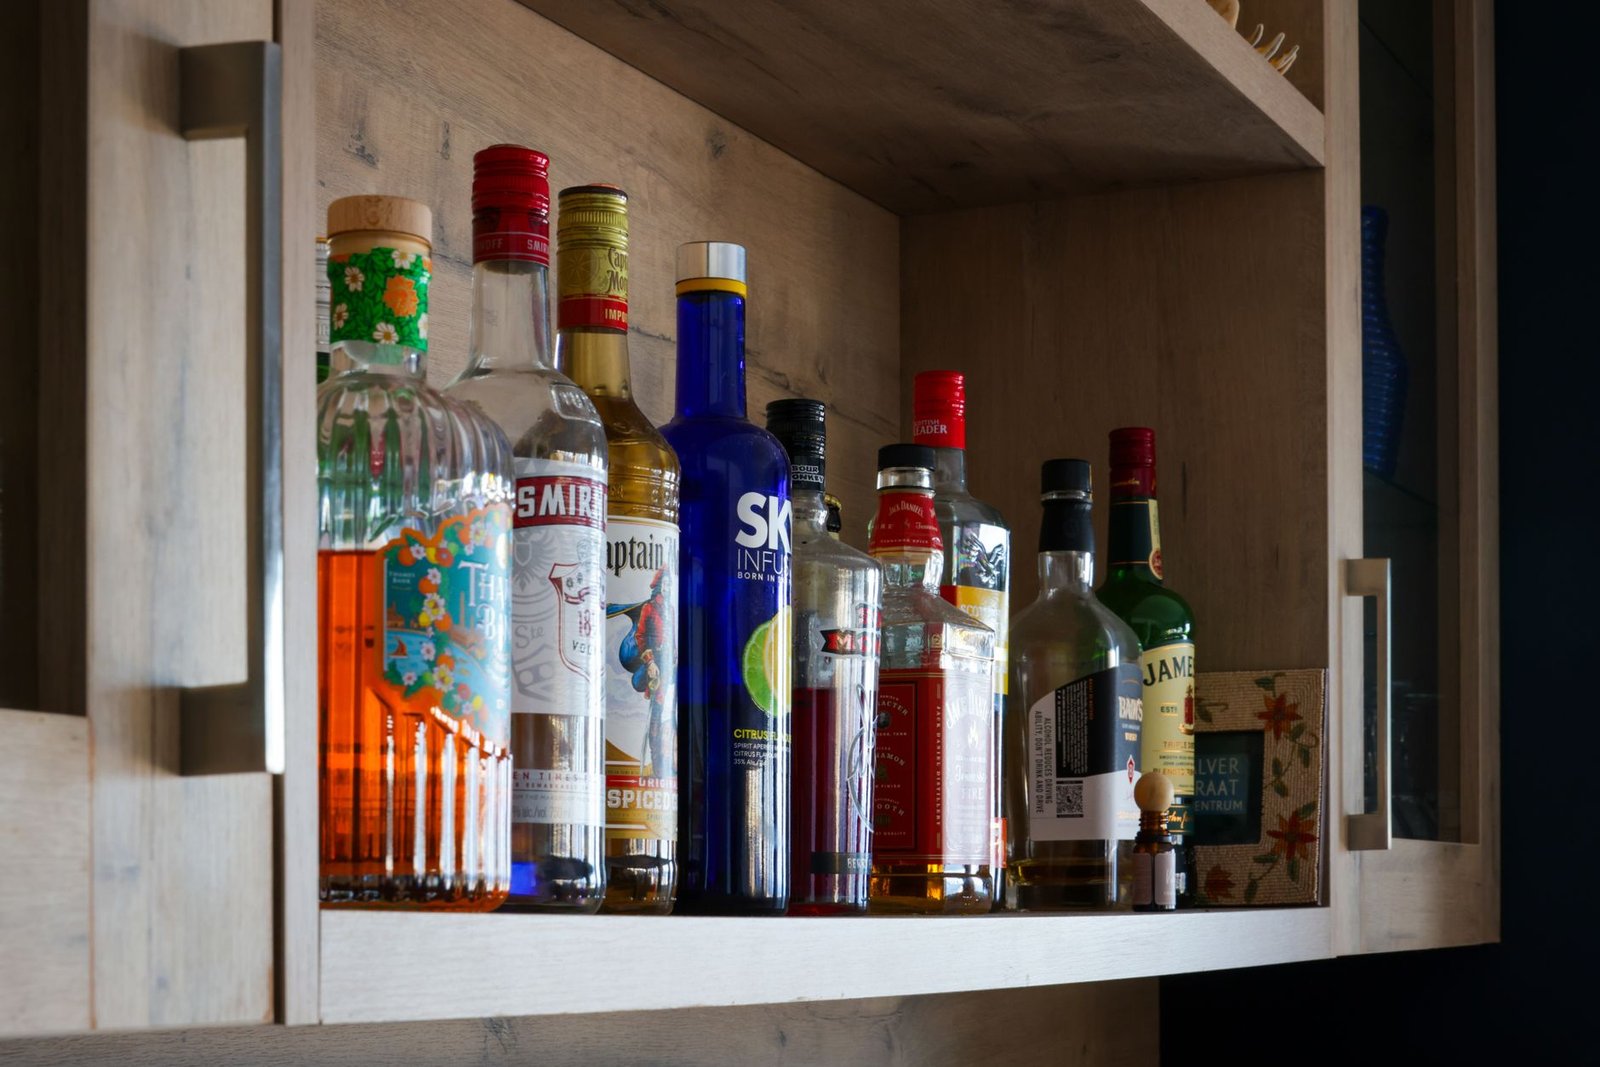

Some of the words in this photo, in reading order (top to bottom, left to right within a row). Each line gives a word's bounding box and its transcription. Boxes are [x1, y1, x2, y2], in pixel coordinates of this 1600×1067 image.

[517, 484, 608, 522] SMIR
[737, 571, 764, 581] BORN
[767, 574, 776, 583] IN
[878, 699, 909, 717] ACTER
[733, 728, 768, 740] CITRUS
[1196, 756, 1241, 776] LVER
